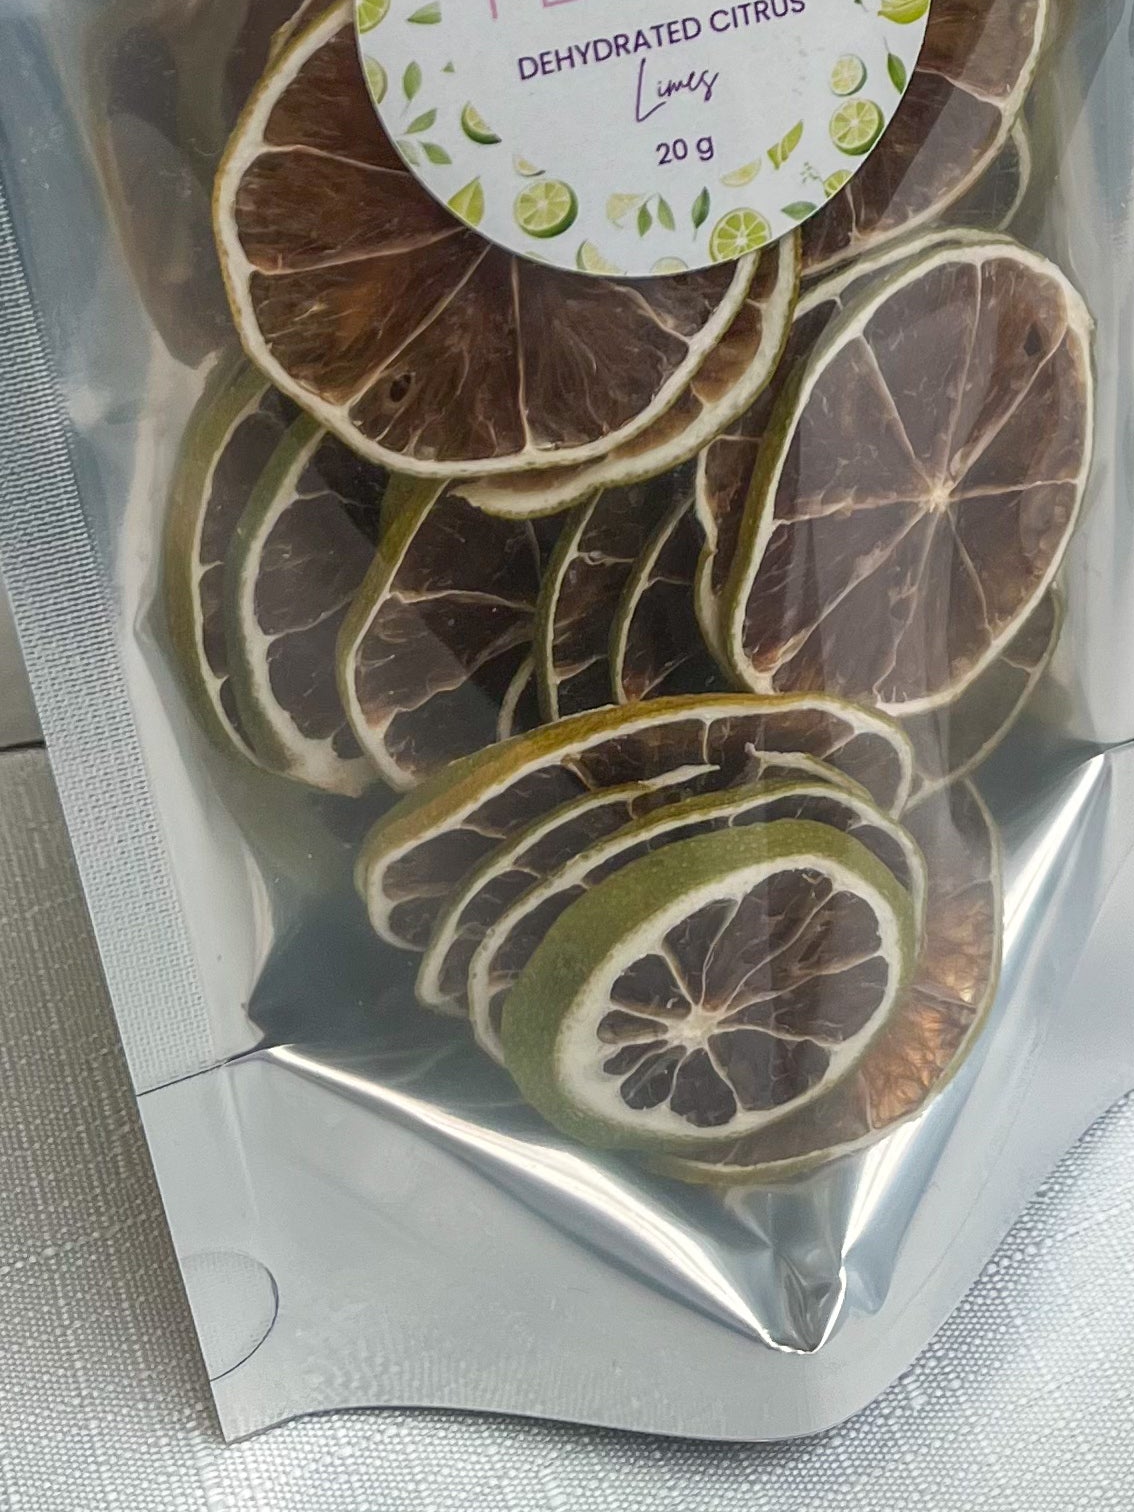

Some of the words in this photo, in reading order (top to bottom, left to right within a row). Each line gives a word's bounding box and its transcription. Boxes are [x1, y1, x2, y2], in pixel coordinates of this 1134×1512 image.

[517, 16, 702, 81] DEHYDRATED
[635, 59, 719, 123] Limes
[655, 139, 689, 165] 20
[696, 136, 715, 162] g
